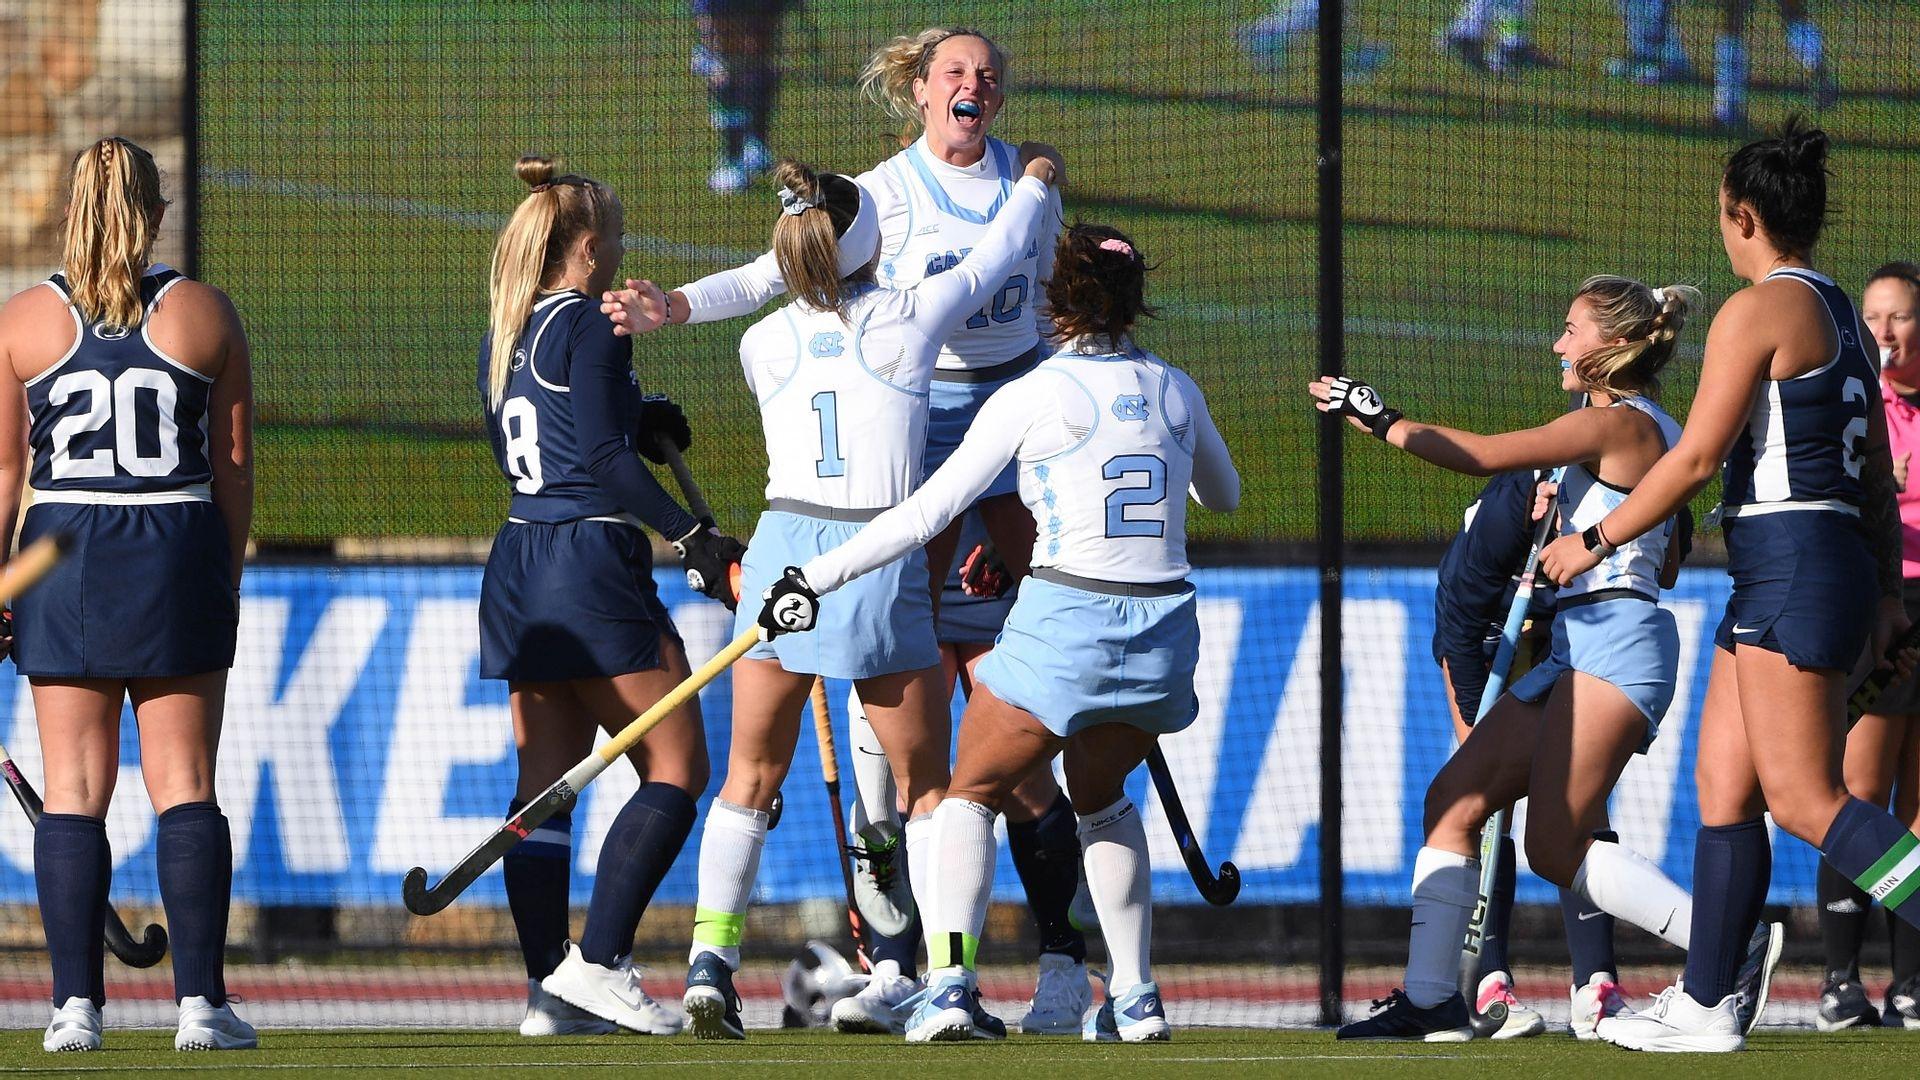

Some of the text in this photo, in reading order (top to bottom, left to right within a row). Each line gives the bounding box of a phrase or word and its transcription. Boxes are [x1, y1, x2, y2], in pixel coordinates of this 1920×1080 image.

[49, 367, 180, 481] 20
[501, 396, 544, 495] 8
[811, 391, 845, 478] 1
[1102, 454, 1168, 539] 2
[1091, 814, 1116, 828] NIKE
